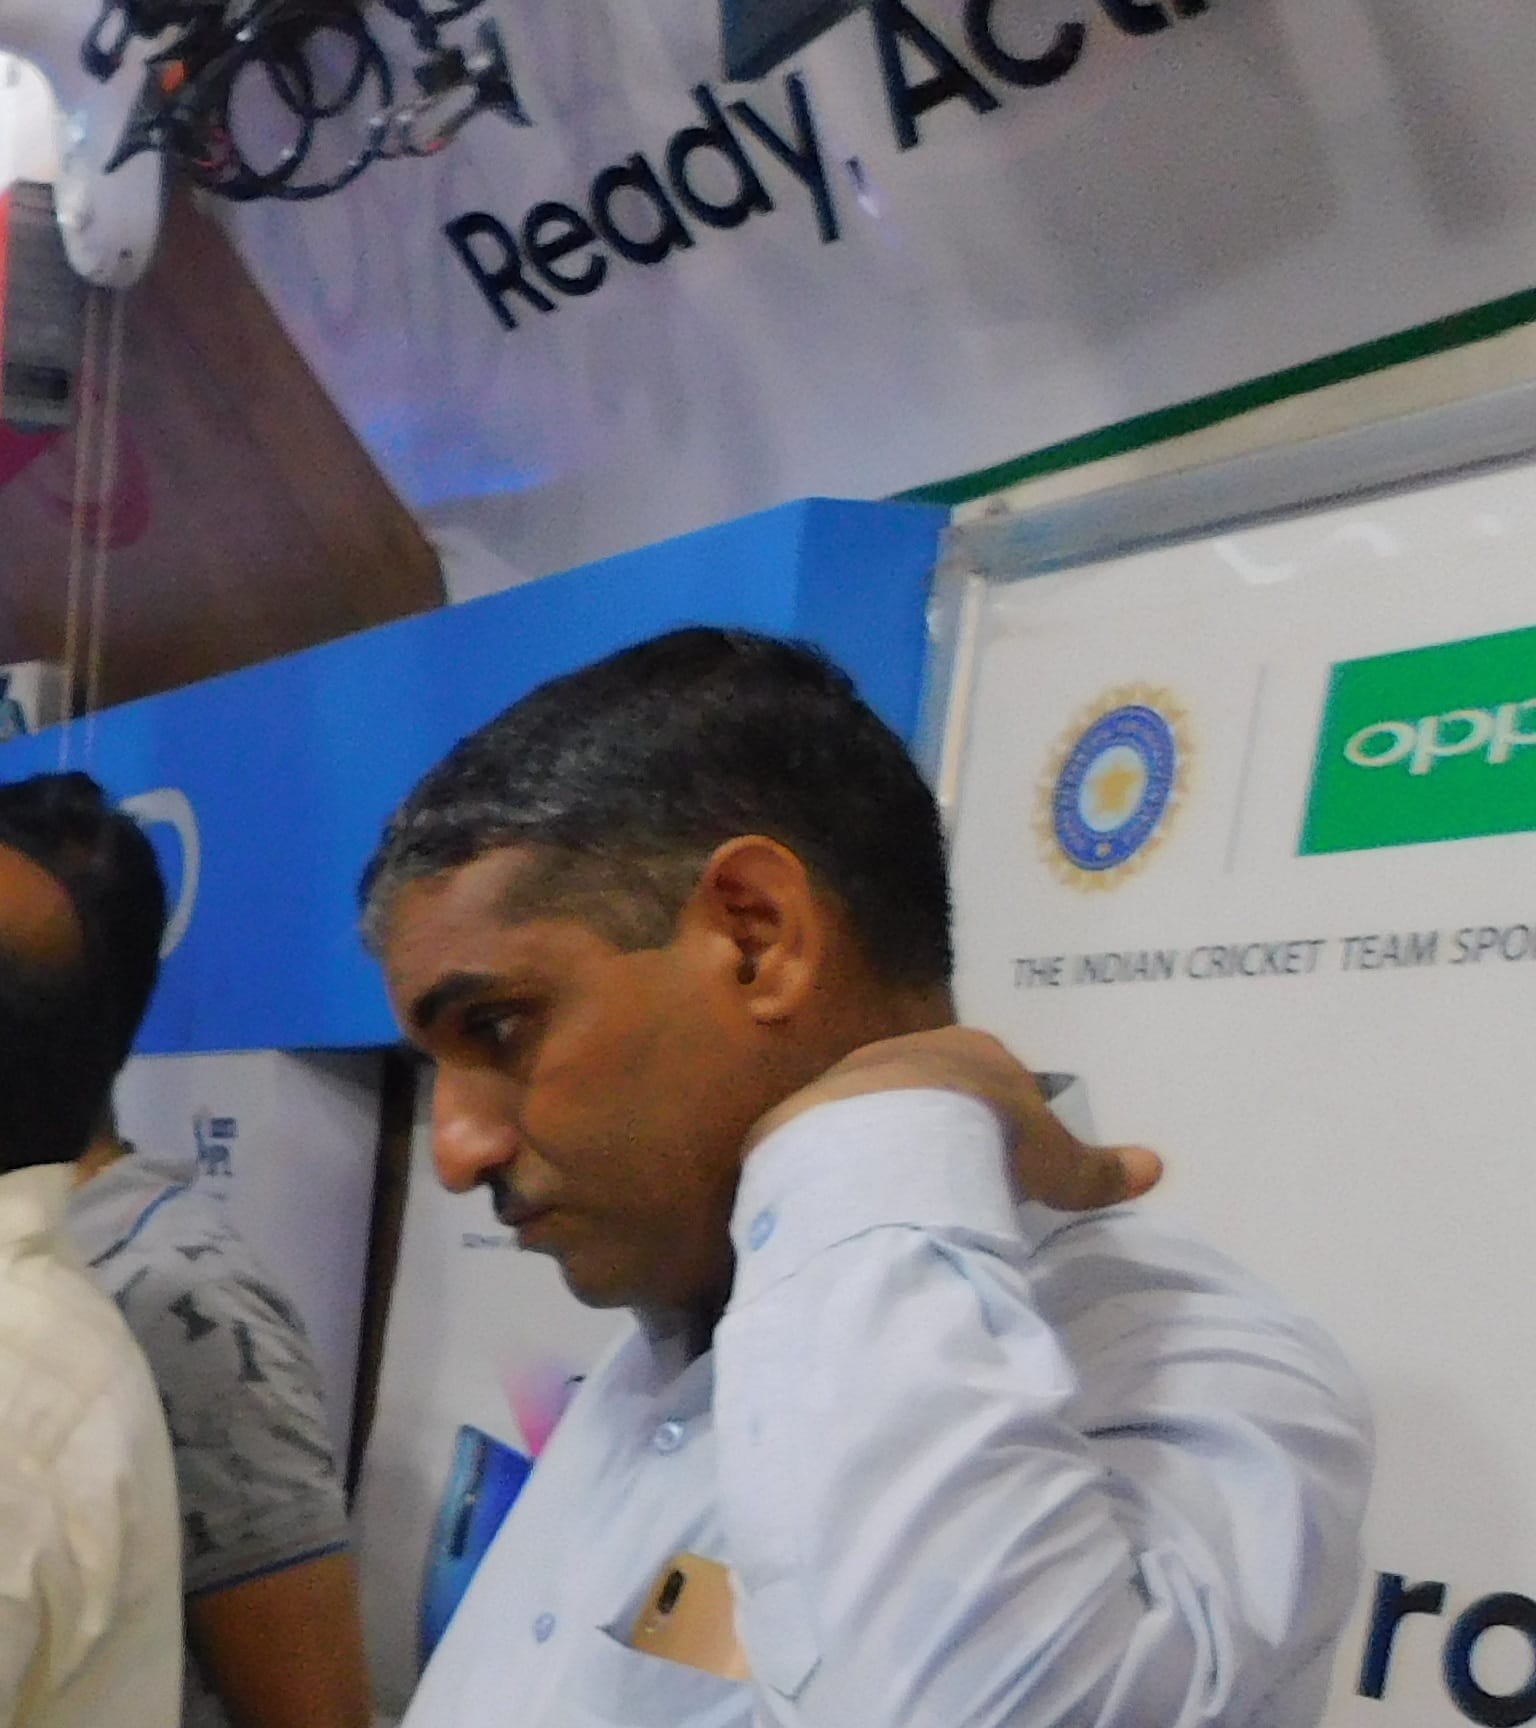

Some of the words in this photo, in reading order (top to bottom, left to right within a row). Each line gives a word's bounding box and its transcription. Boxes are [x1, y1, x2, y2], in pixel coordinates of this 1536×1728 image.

[870, 0, 1211, 152] Ac
[1010, 957, 1063, 989] THE
[1073, 950, 1180, 986] INDIAN
[1186, 938, 1326, 980] CRICKET
[1339, 929, 1440, 972] TEAM
[1447, 922, 1536, 965] SPO
